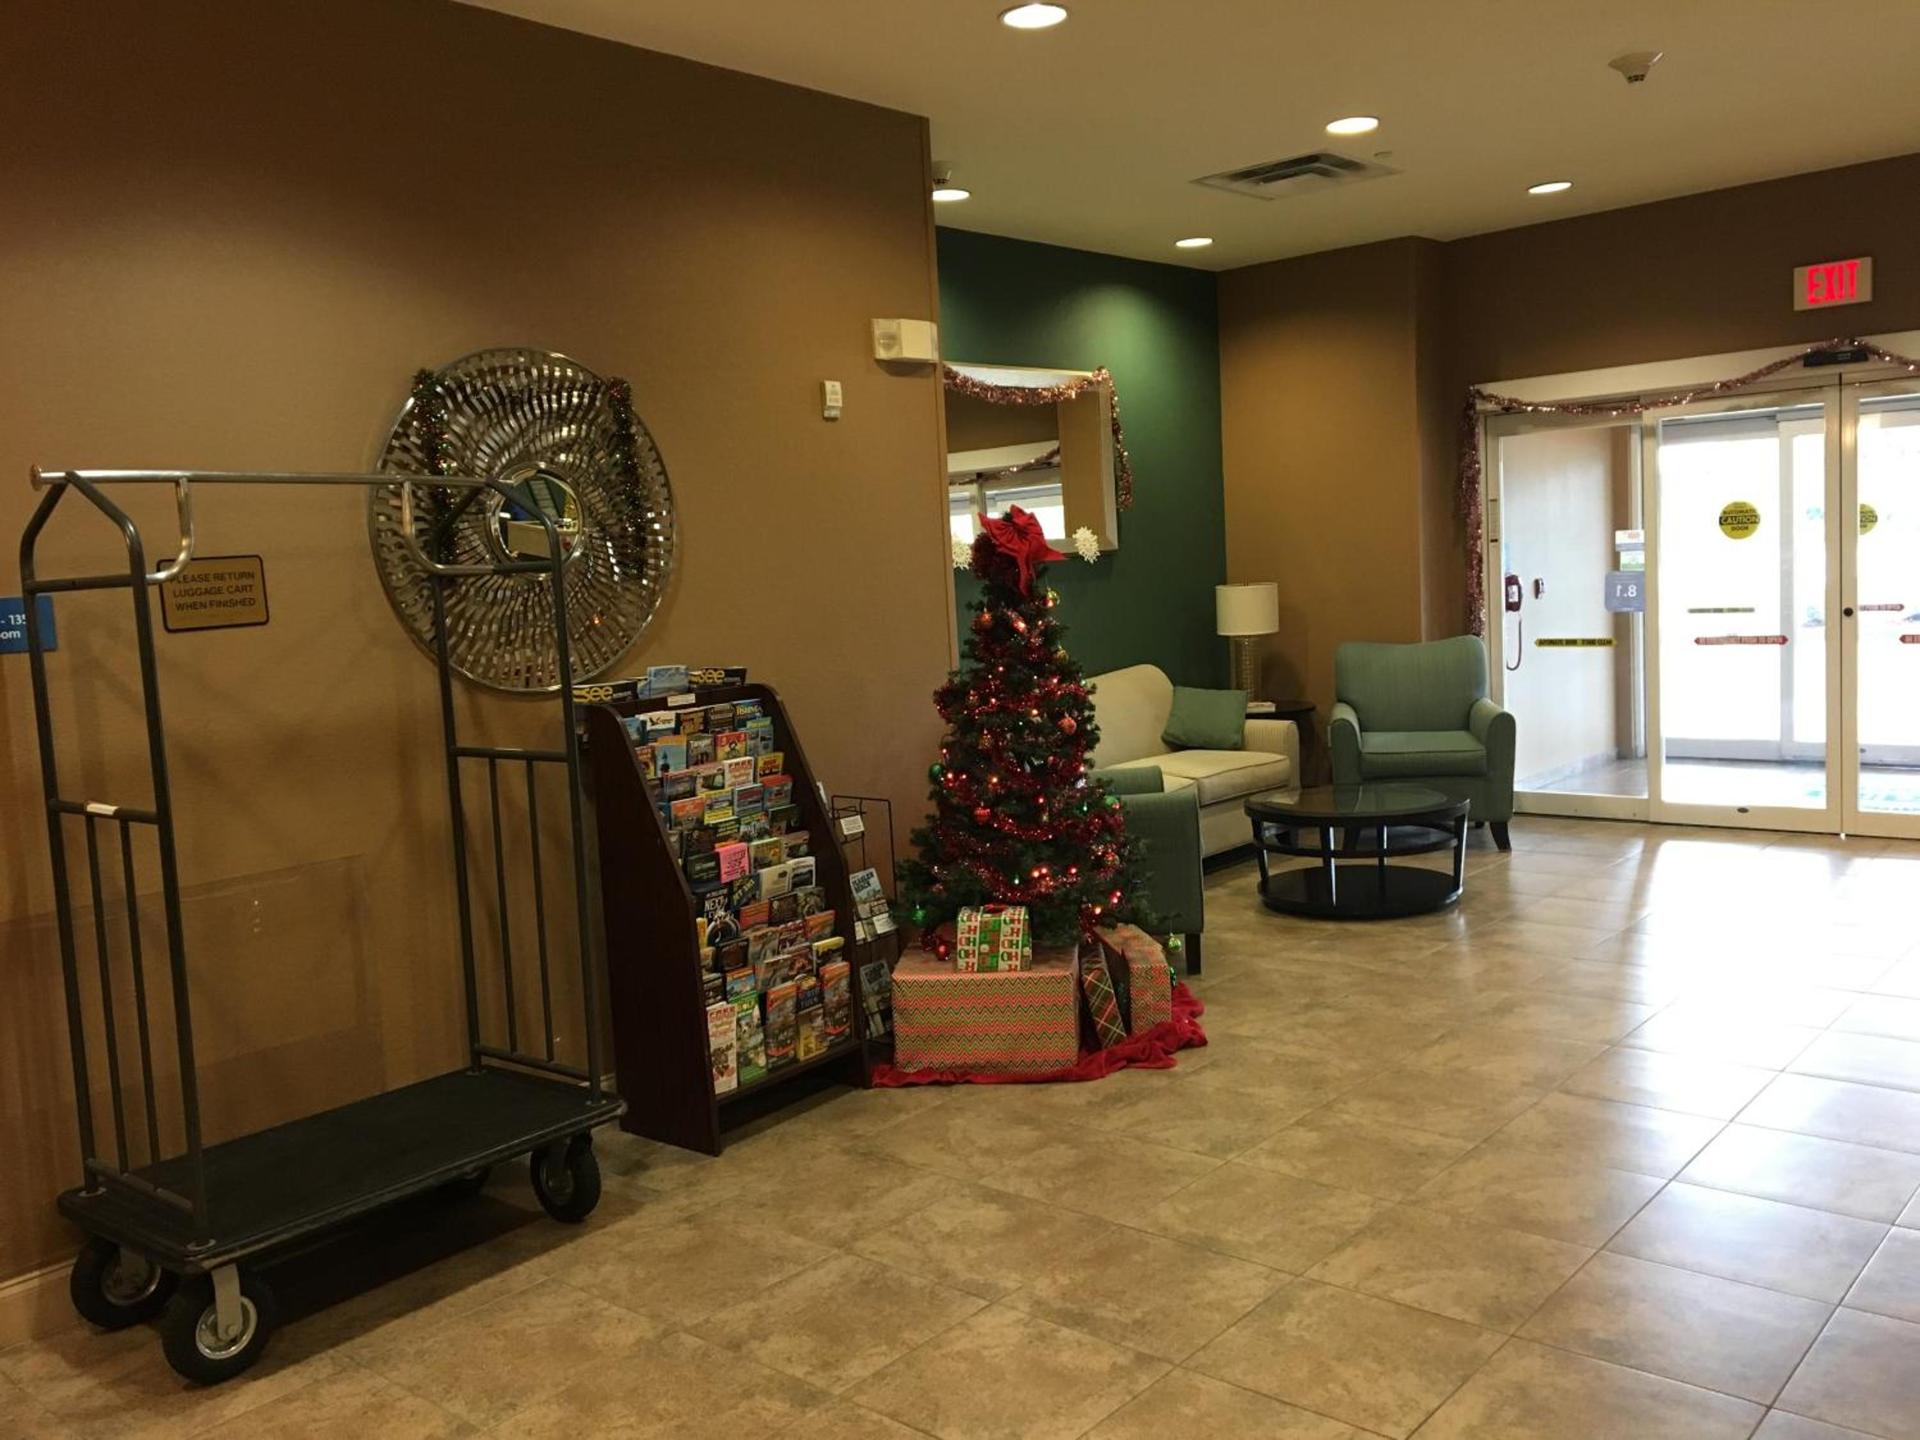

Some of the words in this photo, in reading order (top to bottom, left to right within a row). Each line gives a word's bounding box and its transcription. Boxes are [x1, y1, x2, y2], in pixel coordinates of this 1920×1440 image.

[1807, 261, 1861, 304] EXIT
[1721, 514, 1760, 525] CAUTION
[213, 571, 255, 581] RETURN
[173, 586, 224, 598] LUGGAGE
[226, 584, 254, 594] CART
[175, 600, 207, 611] WHEN
[209, 597, 256, 609] FINISHED
